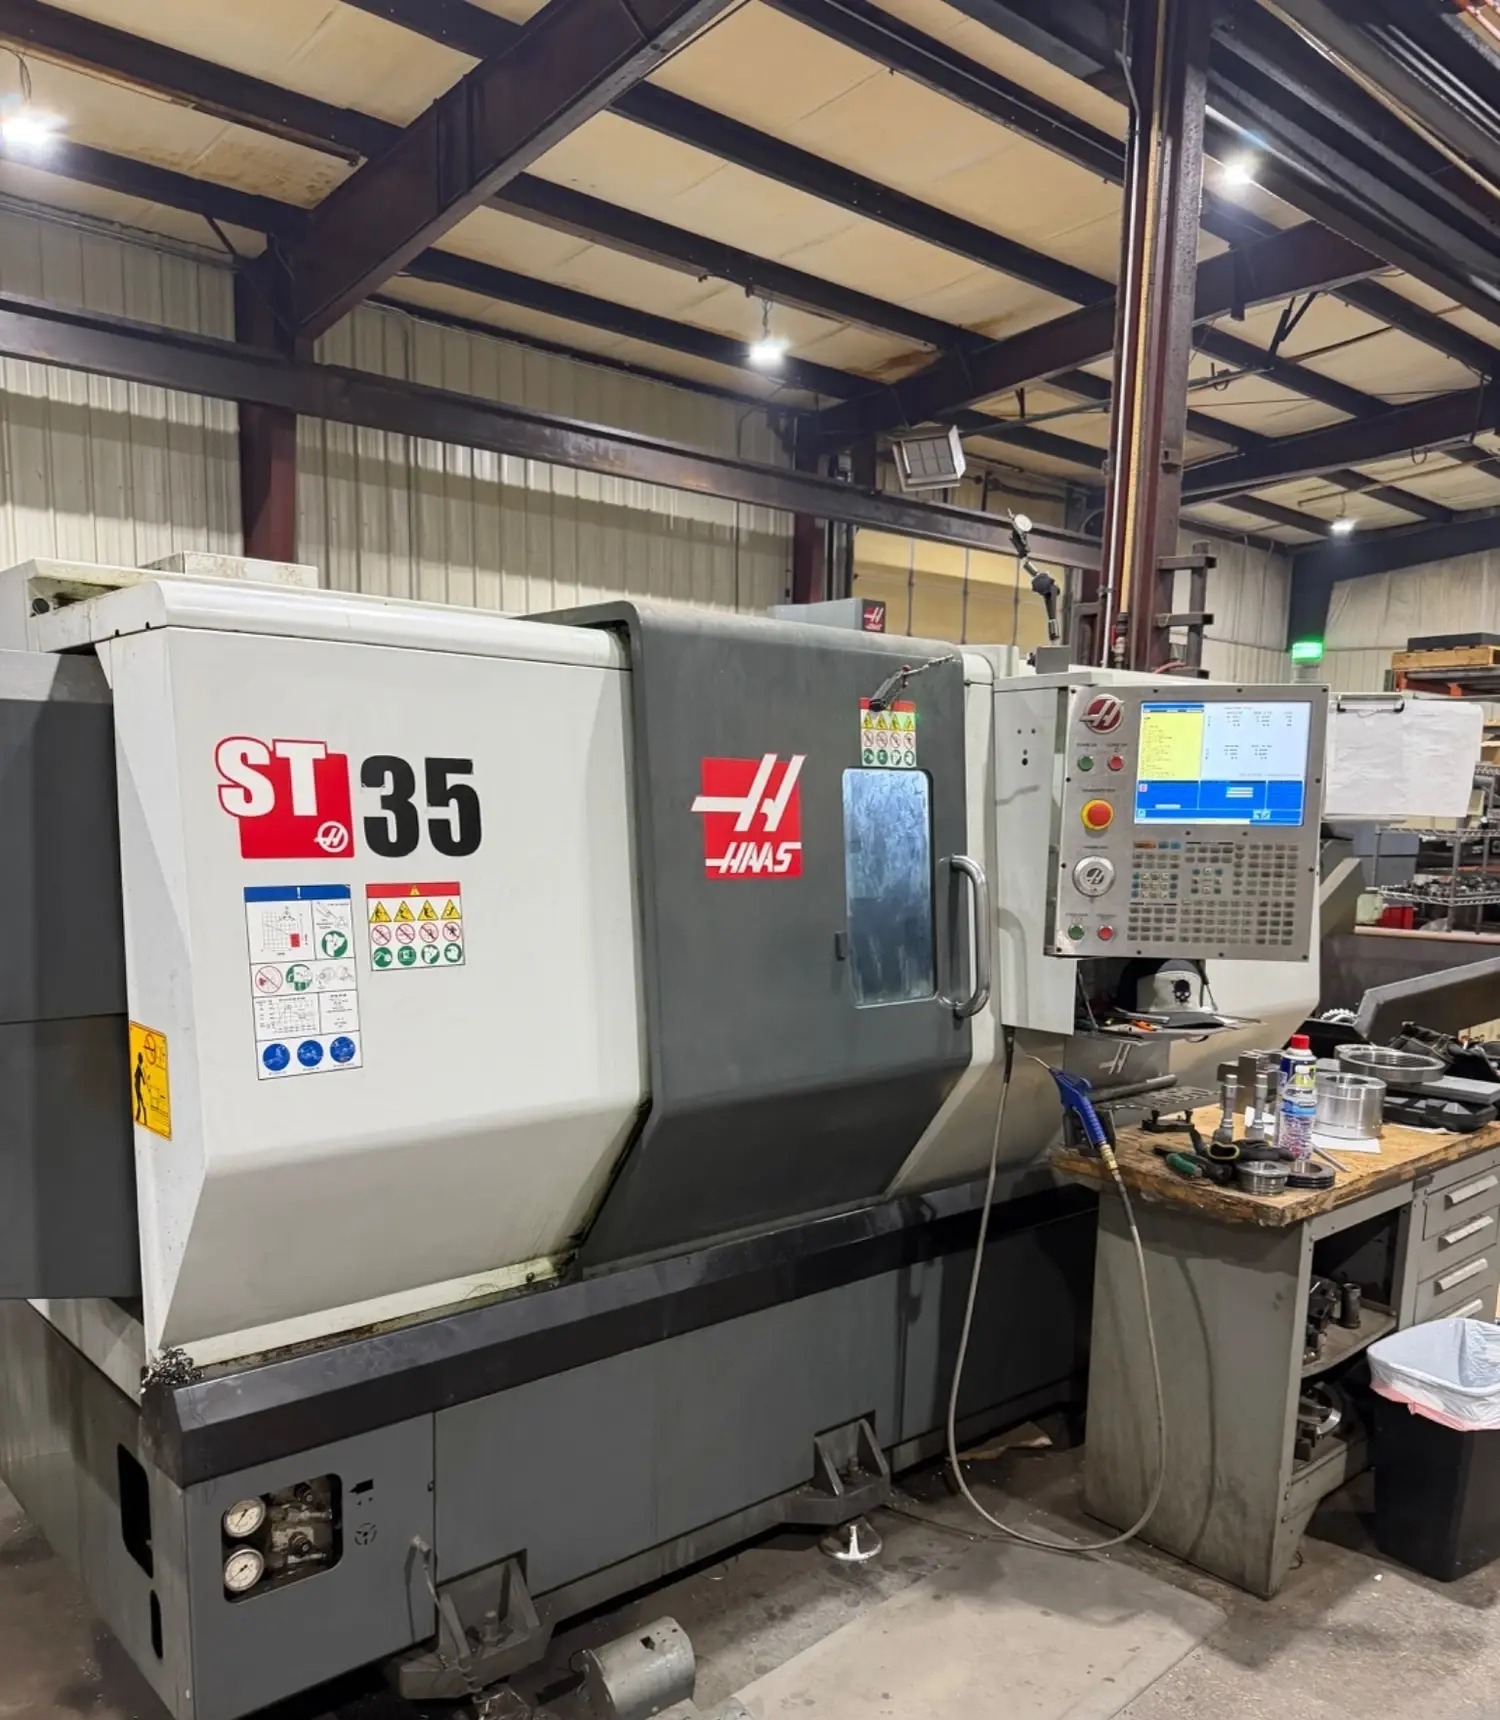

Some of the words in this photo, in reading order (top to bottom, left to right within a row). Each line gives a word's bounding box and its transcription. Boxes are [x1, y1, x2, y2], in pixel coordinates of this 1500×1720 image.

[216, 736, 327, 818] ST
[360, 755, 482, 857] 35
[705, 841, 802, 874] HAAS
